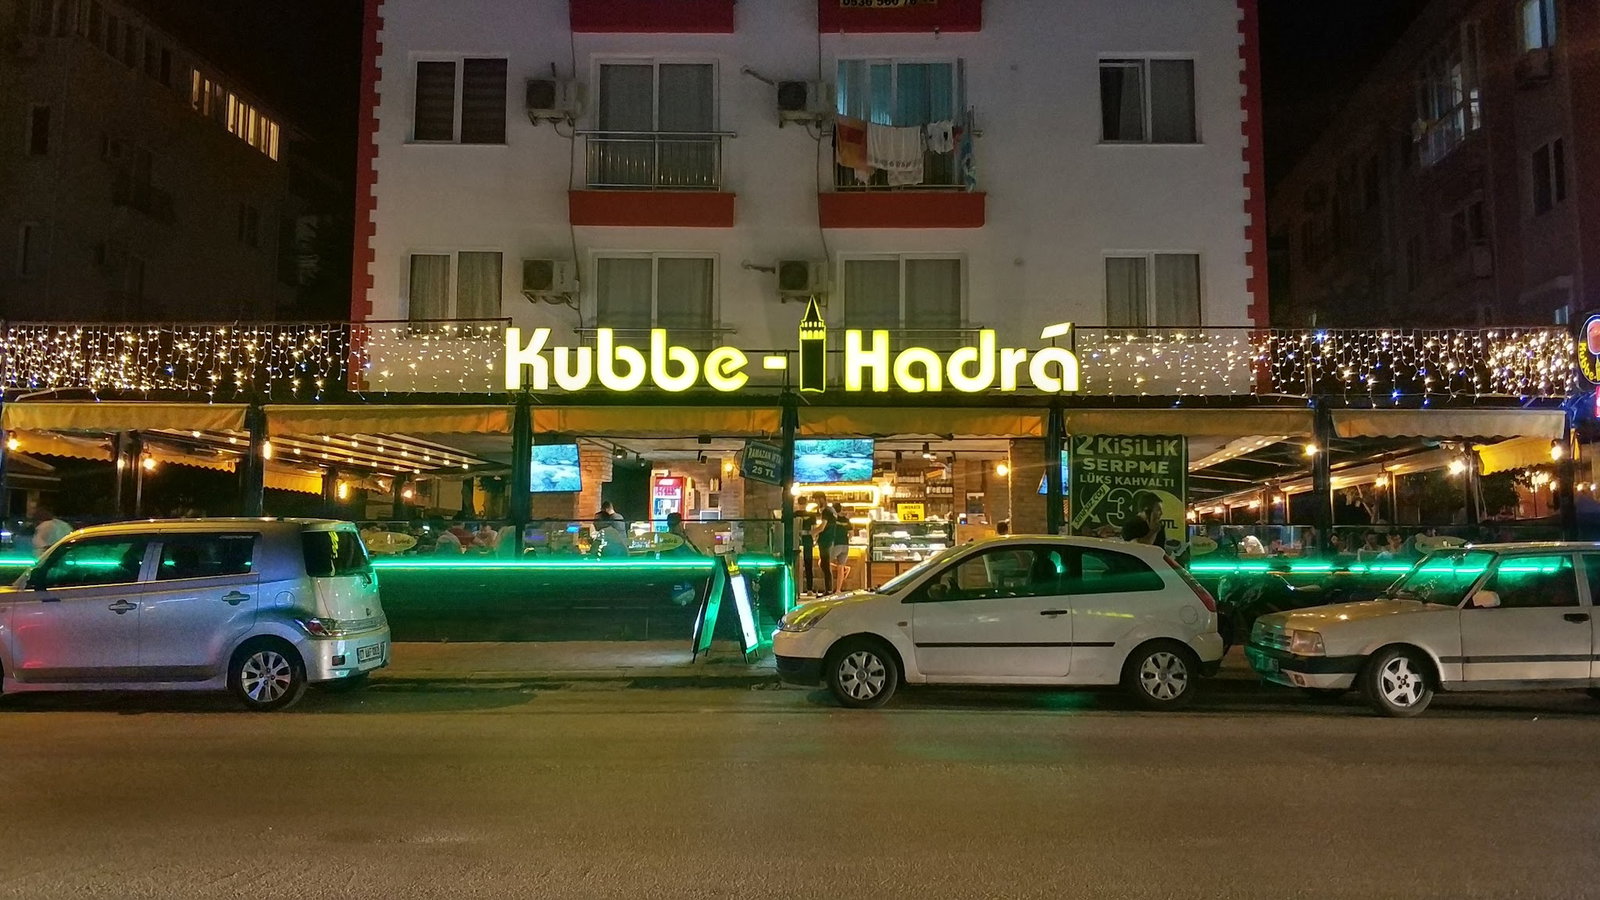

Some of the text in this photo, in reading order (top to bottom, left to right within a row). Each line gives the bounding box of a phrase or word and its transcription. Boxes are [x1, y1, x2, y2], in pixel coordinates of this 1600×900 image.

[1076, 435, 1094, 455] 2
[751, 465, 776, 478] 25 TL
[1082, 457, 1169, 474] SERPME
[1080, 473, 1175, 487] LÜKS KAHVALTI
